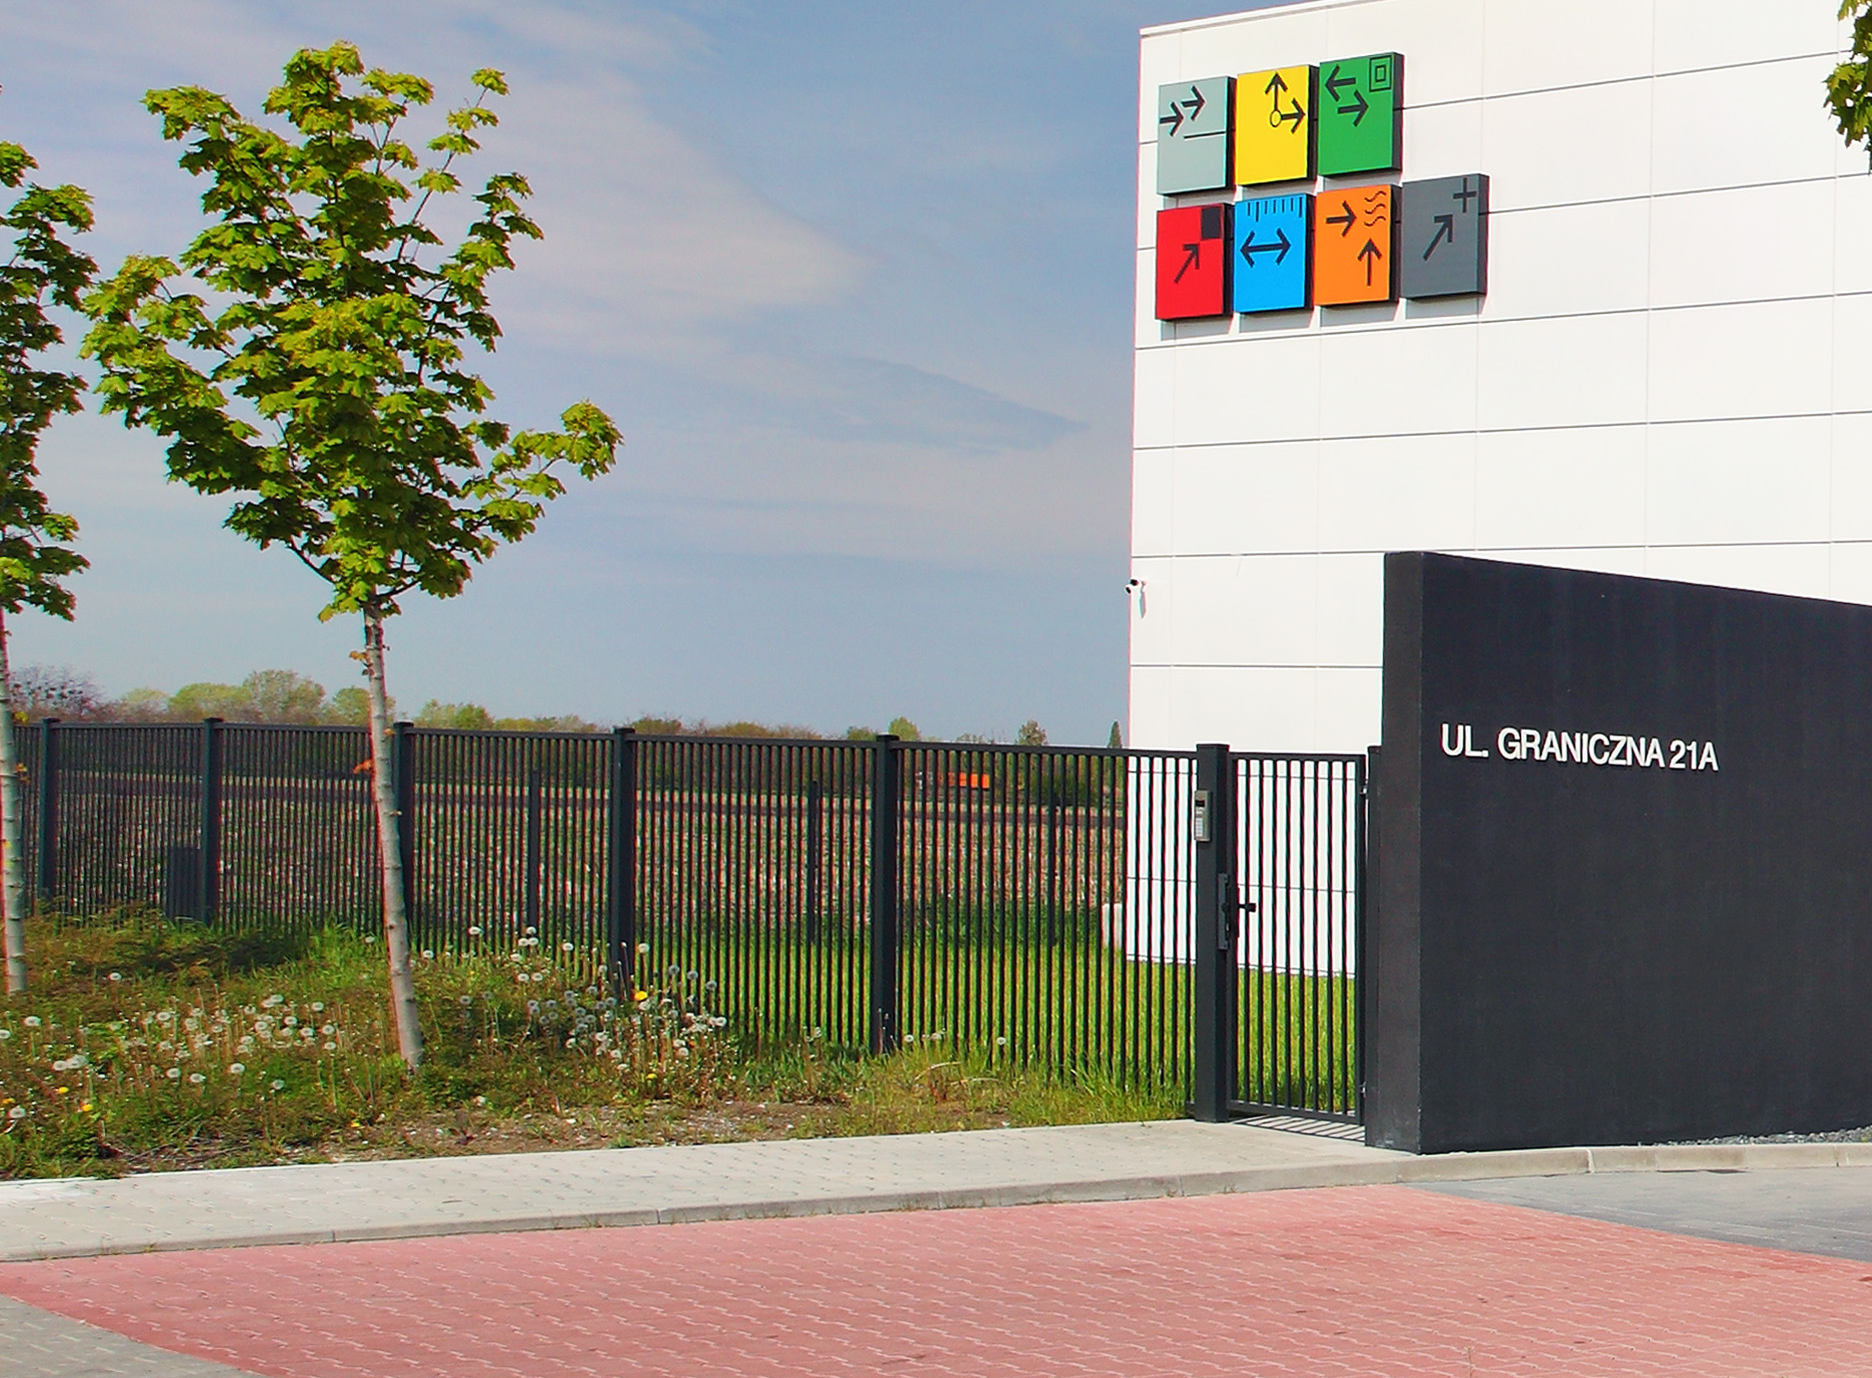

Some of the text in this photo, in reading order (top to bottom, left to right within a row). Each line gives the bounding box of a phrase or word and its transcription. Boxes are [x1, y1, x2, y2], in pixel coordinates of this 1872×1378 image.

[1441, 723, 1719, 771] UL. GRANICZNA 21A
